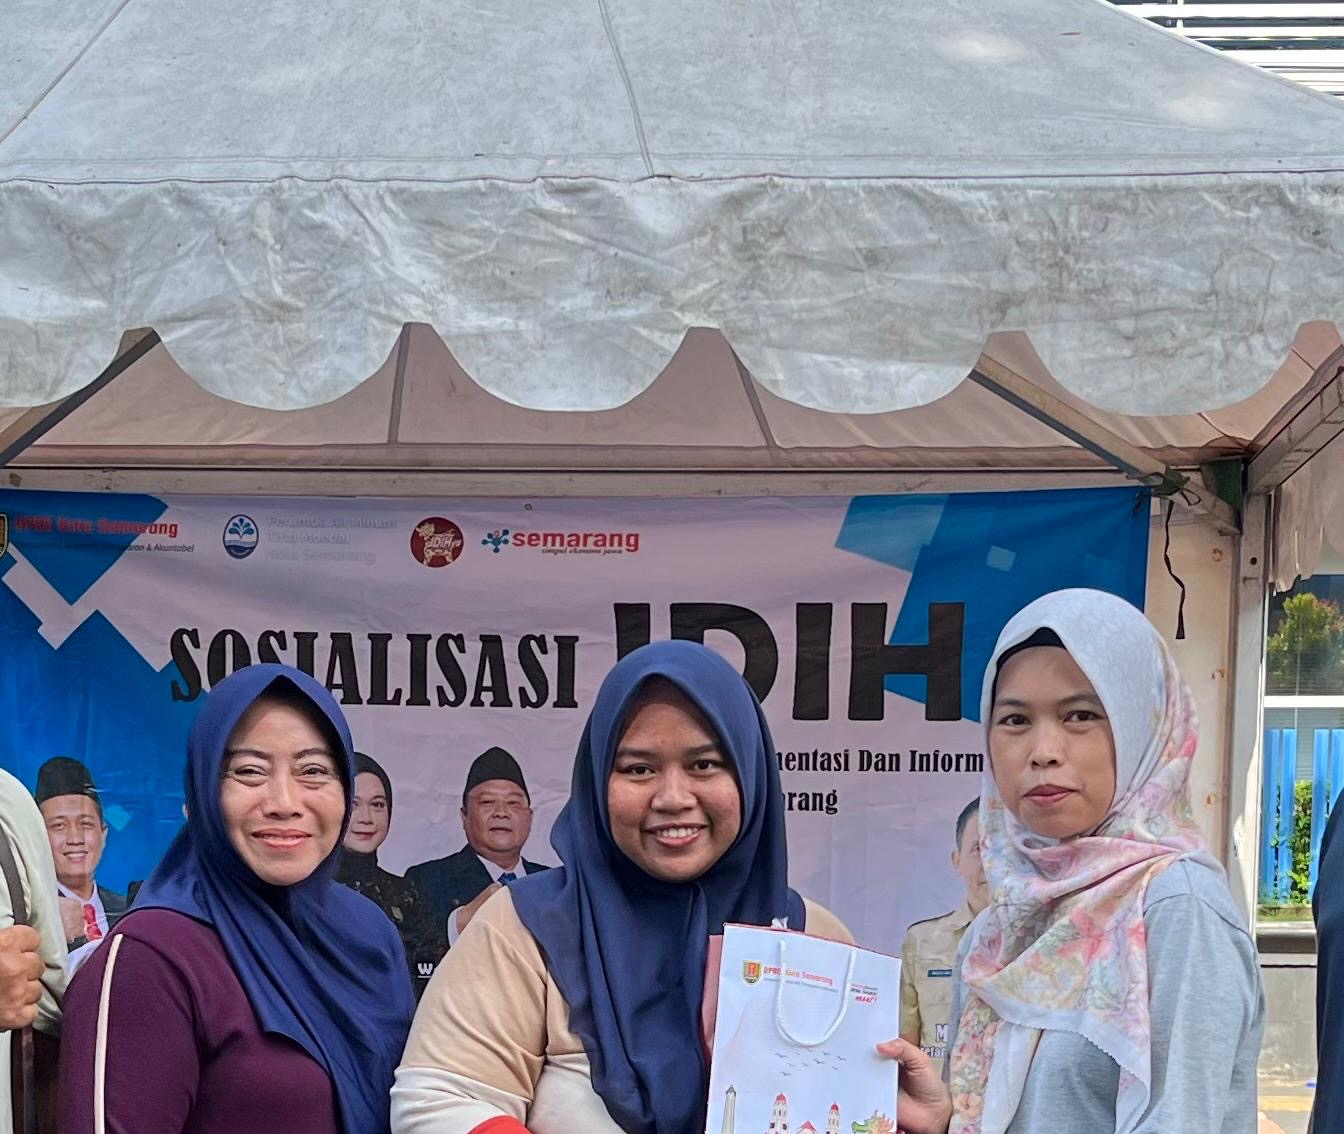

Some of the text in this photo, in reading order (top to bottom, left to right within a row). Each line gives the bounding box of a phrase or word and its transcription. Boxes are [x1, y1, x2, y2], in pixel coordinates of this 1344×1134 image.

[511, 532, 640, 552] semarang
[858, 750, 901, 772] Dan
[783, 790, 838, 815] rang
